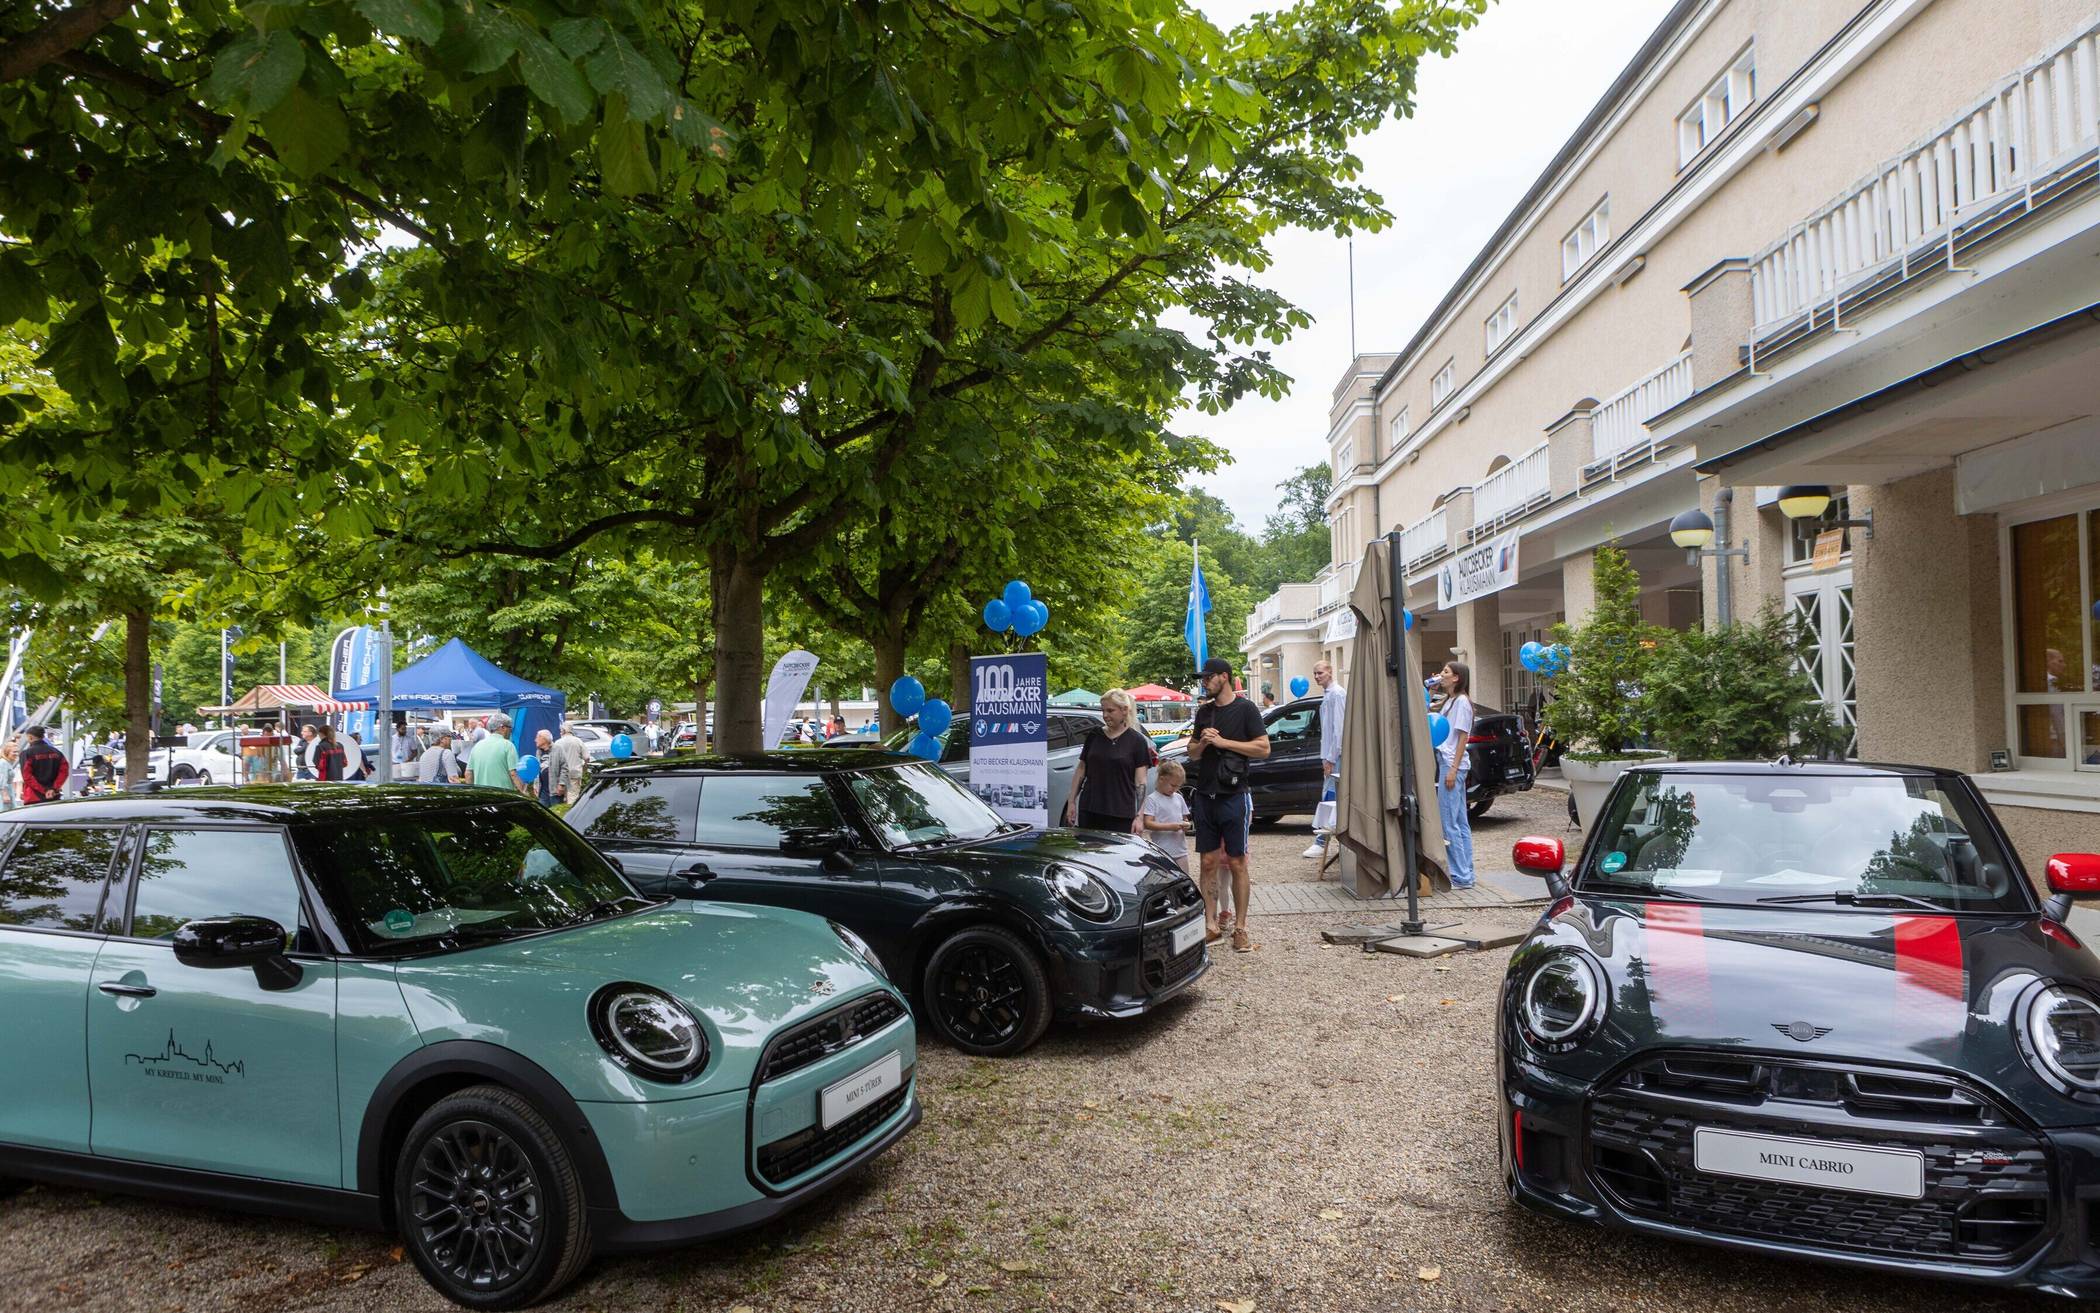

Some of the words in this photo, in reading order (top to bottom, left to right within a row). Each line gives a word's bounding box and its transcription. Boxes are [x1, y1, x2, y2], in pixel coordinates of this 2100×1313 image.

[1458, 546, 1494, 579] AUTOBECKER
[975, 664, 1015, 702] 100
[1016, 677, 1041, 687] JAHRE
[975, 701, 1042, 716] KLAUSMANN
[973, 758, 988, 766] AUTO
[988, 758, 1009, 766] BECKER
[1009, 758, 1044, 767] KLAUSMANN
[145, 1068, 156, 1077] MY
[193, 1072, 204, 1082] MY
[845, 1088, 860, 1103] MINI
[1760, 1152, 1796, 1168] MINI
[1799, 1157, 1855, 1175] CABRIO
